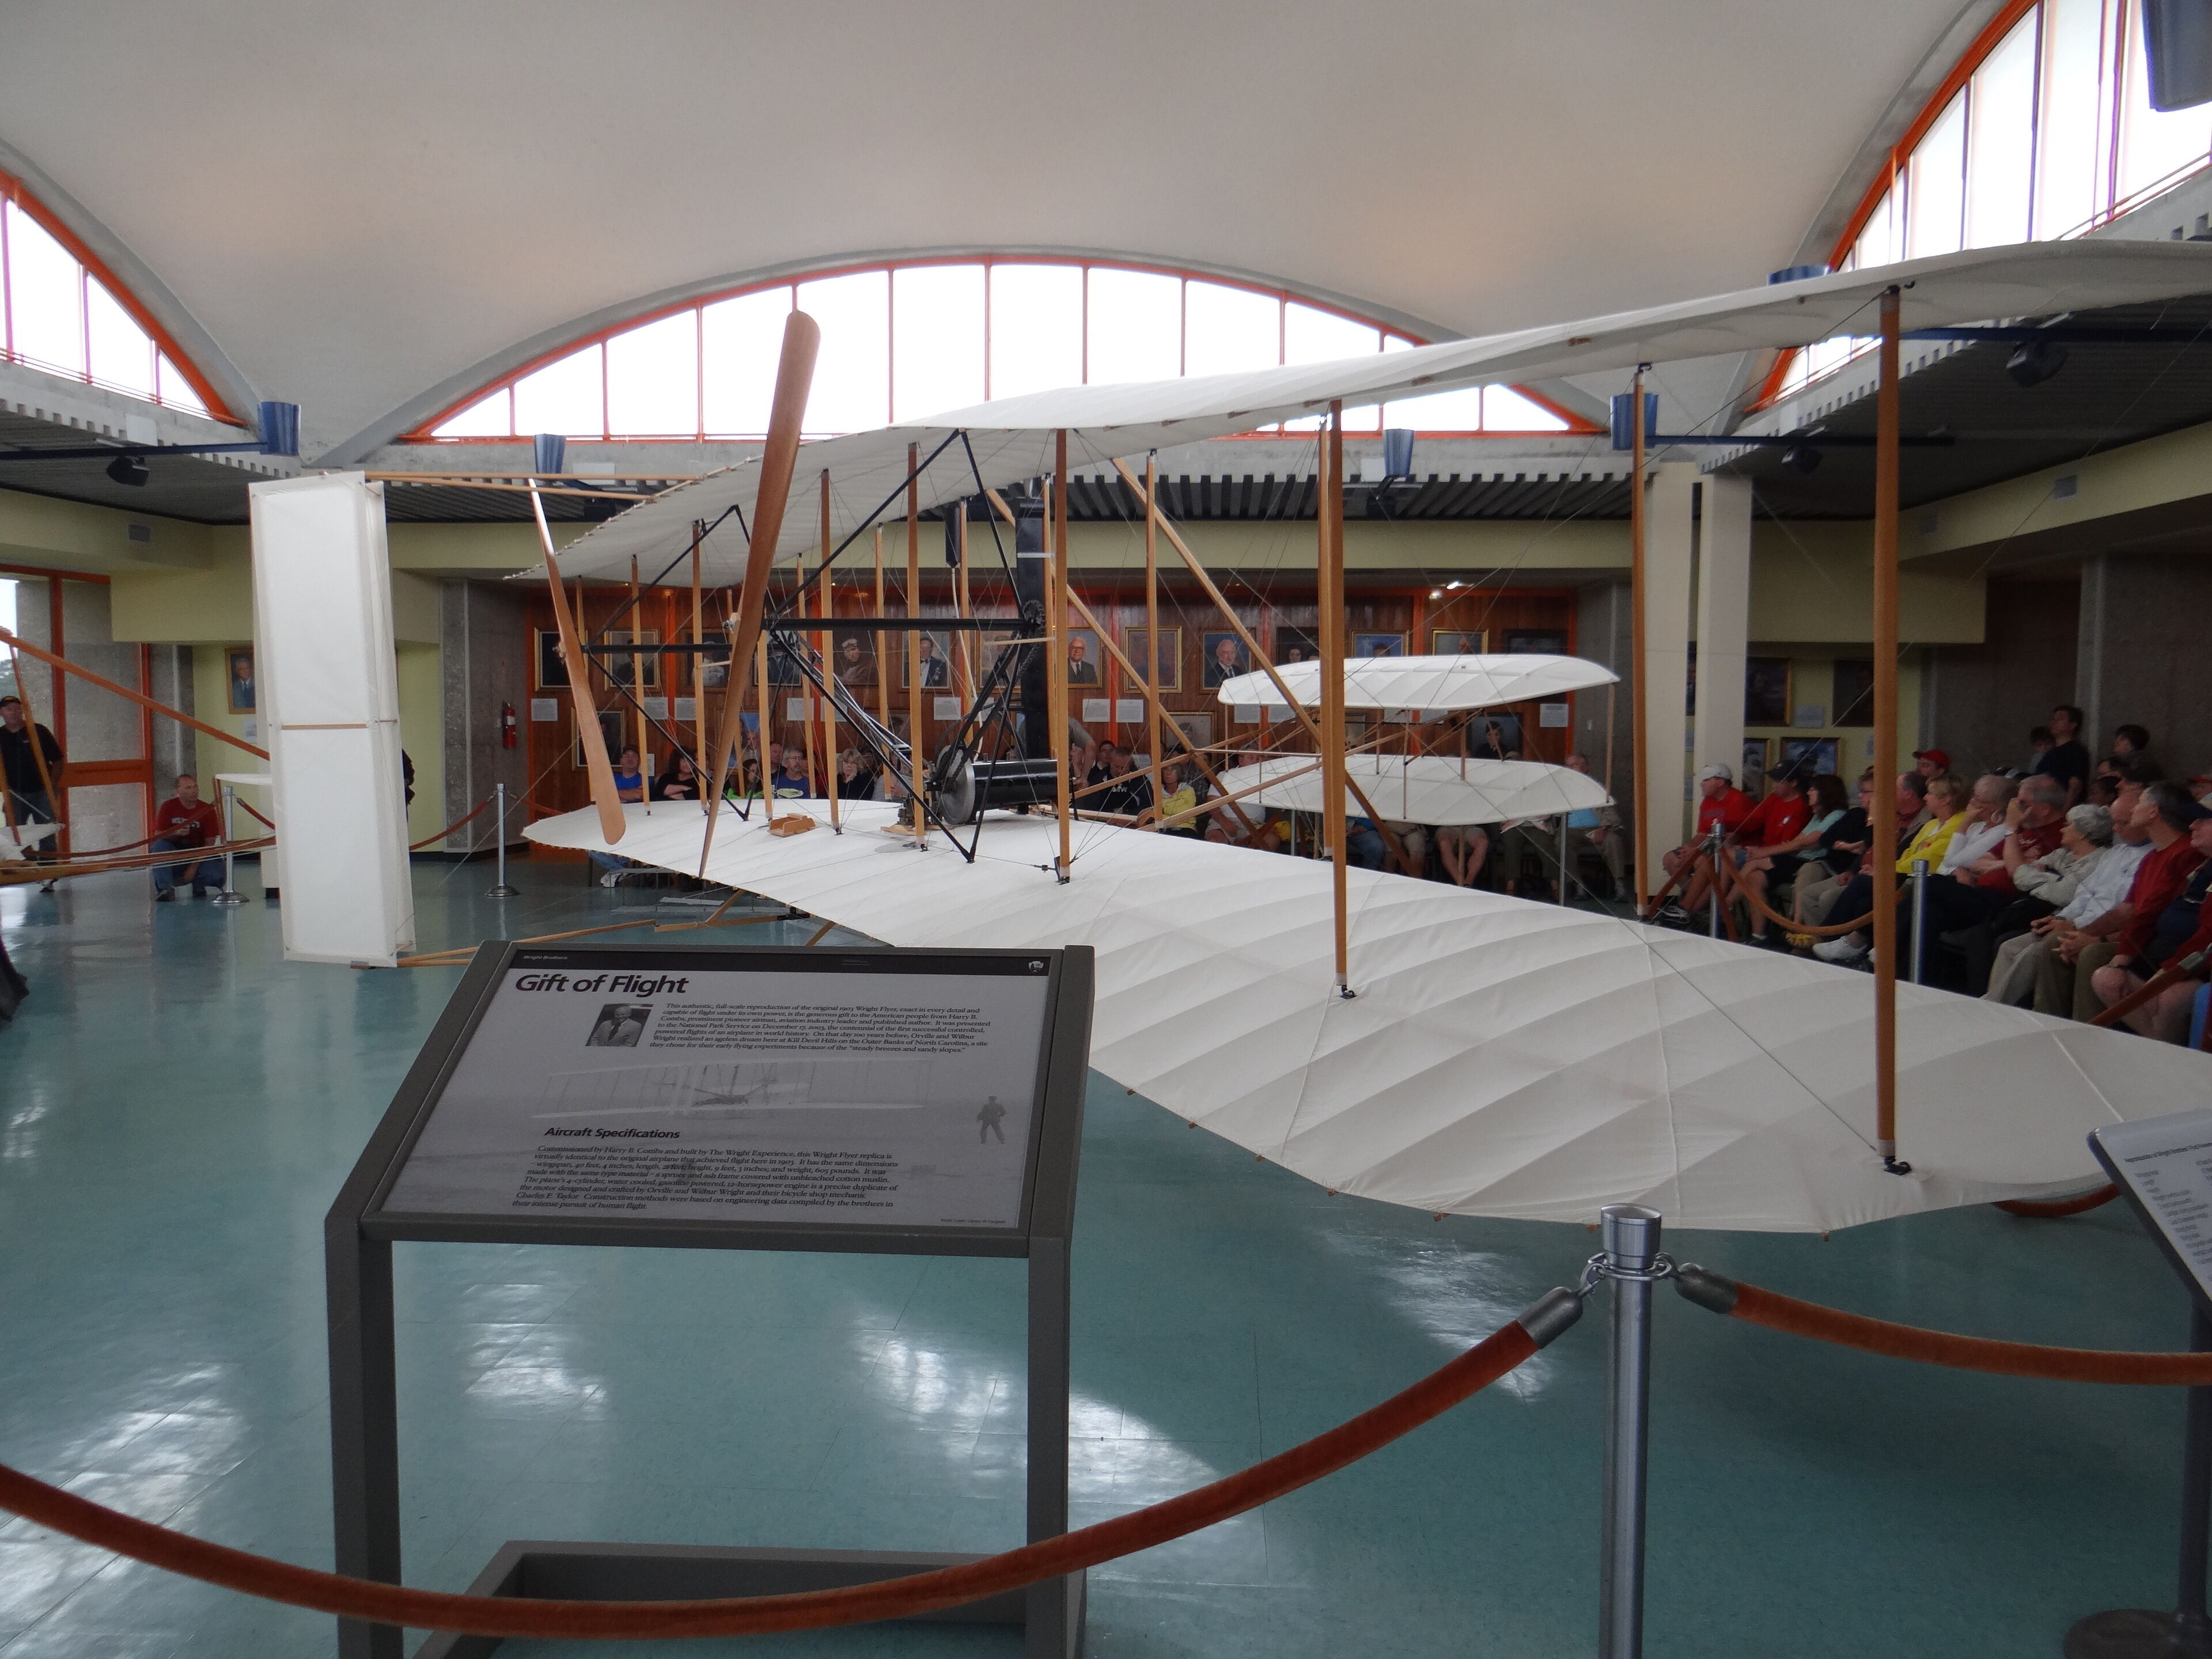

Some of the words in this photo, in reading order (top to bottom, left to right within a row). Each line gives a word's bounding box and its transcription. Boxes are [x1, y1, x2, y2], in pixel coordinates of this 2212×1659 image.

[516, 974, 569, 991] Gift
[573, 974, 609, 992] of
[608, 975, 690, 998] Flight
[544, 1127, 593, 1137] Aircraft
[594, 1128, 680, 1139] Specifications
